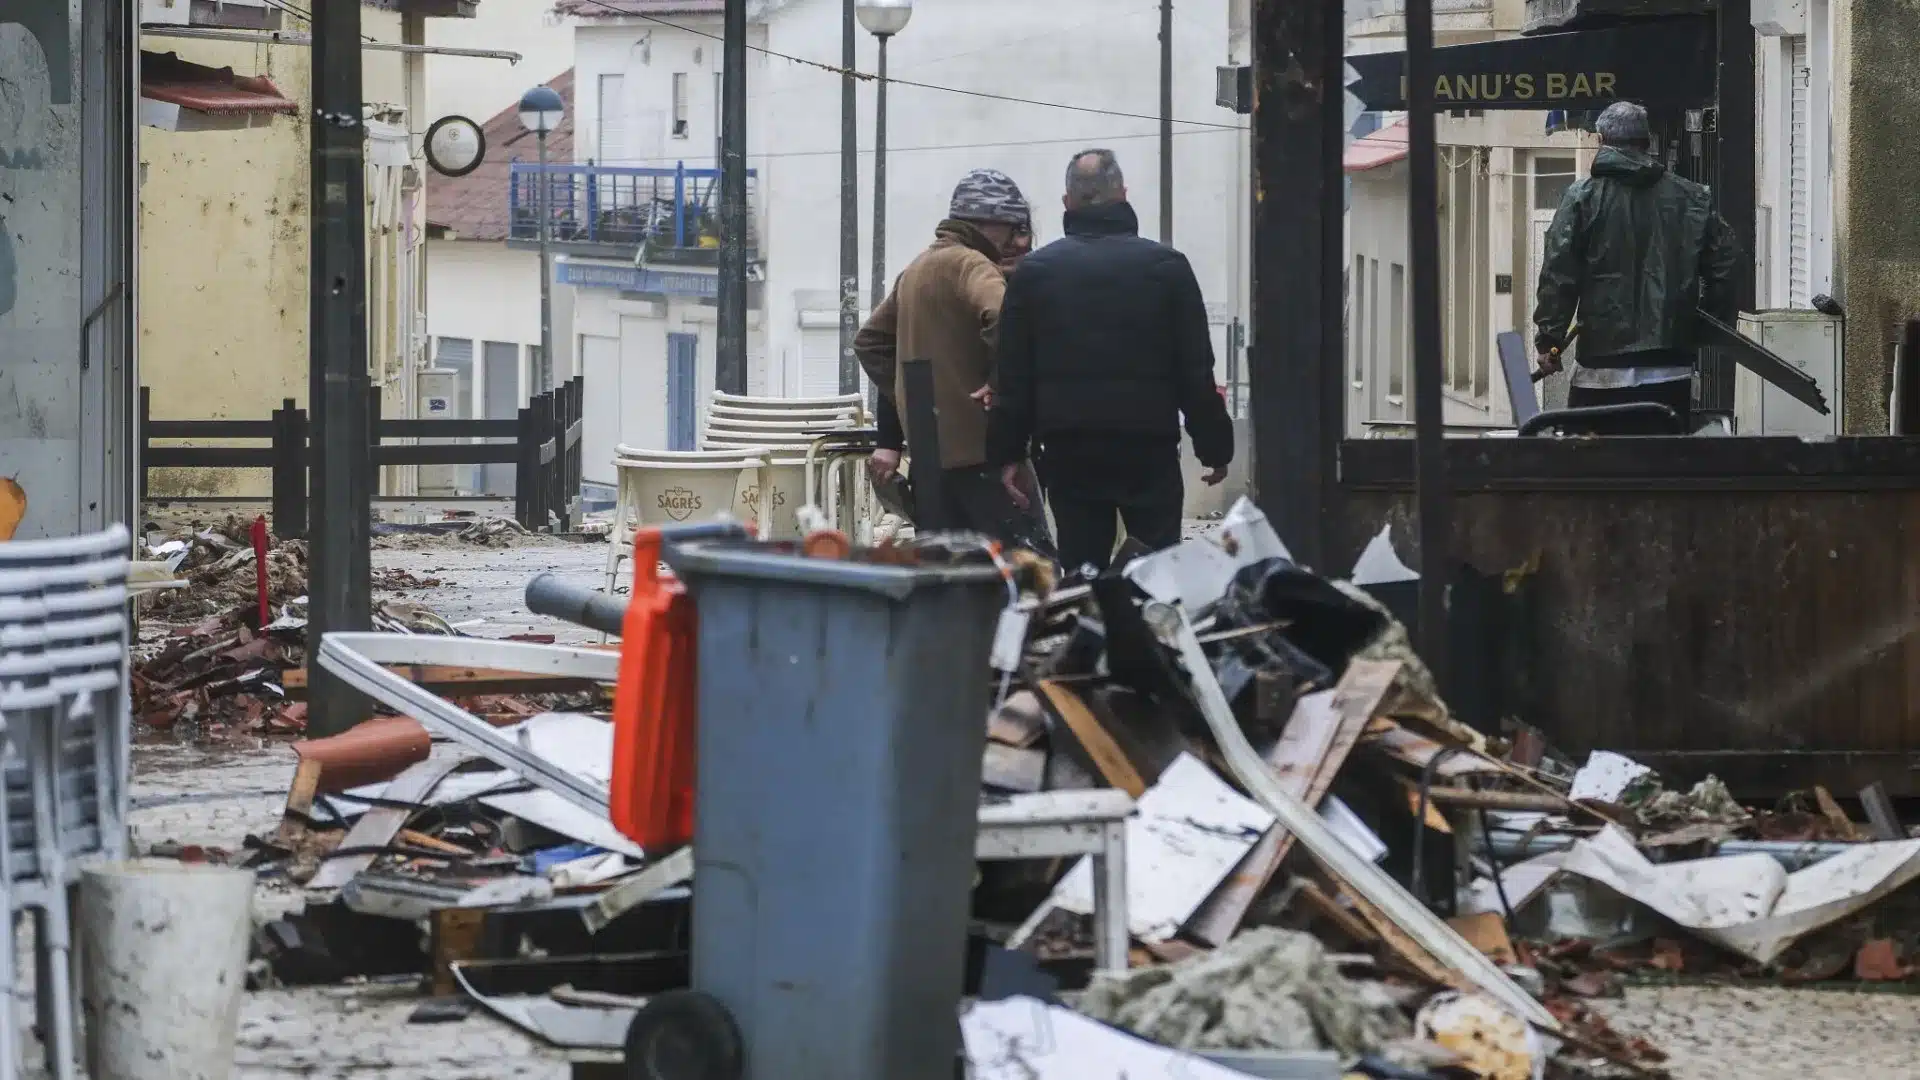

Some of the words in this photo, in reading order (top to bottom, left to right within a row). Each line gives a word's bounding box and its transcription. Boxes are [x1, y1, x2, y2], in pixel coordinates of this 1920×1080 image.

[1400, 73, 1534, 100] ANU’S
[1546, 72, 1617, 99] BAR
[657, 494, 702, 510] SAGRES
[741, 490, 786, 506] SAES
